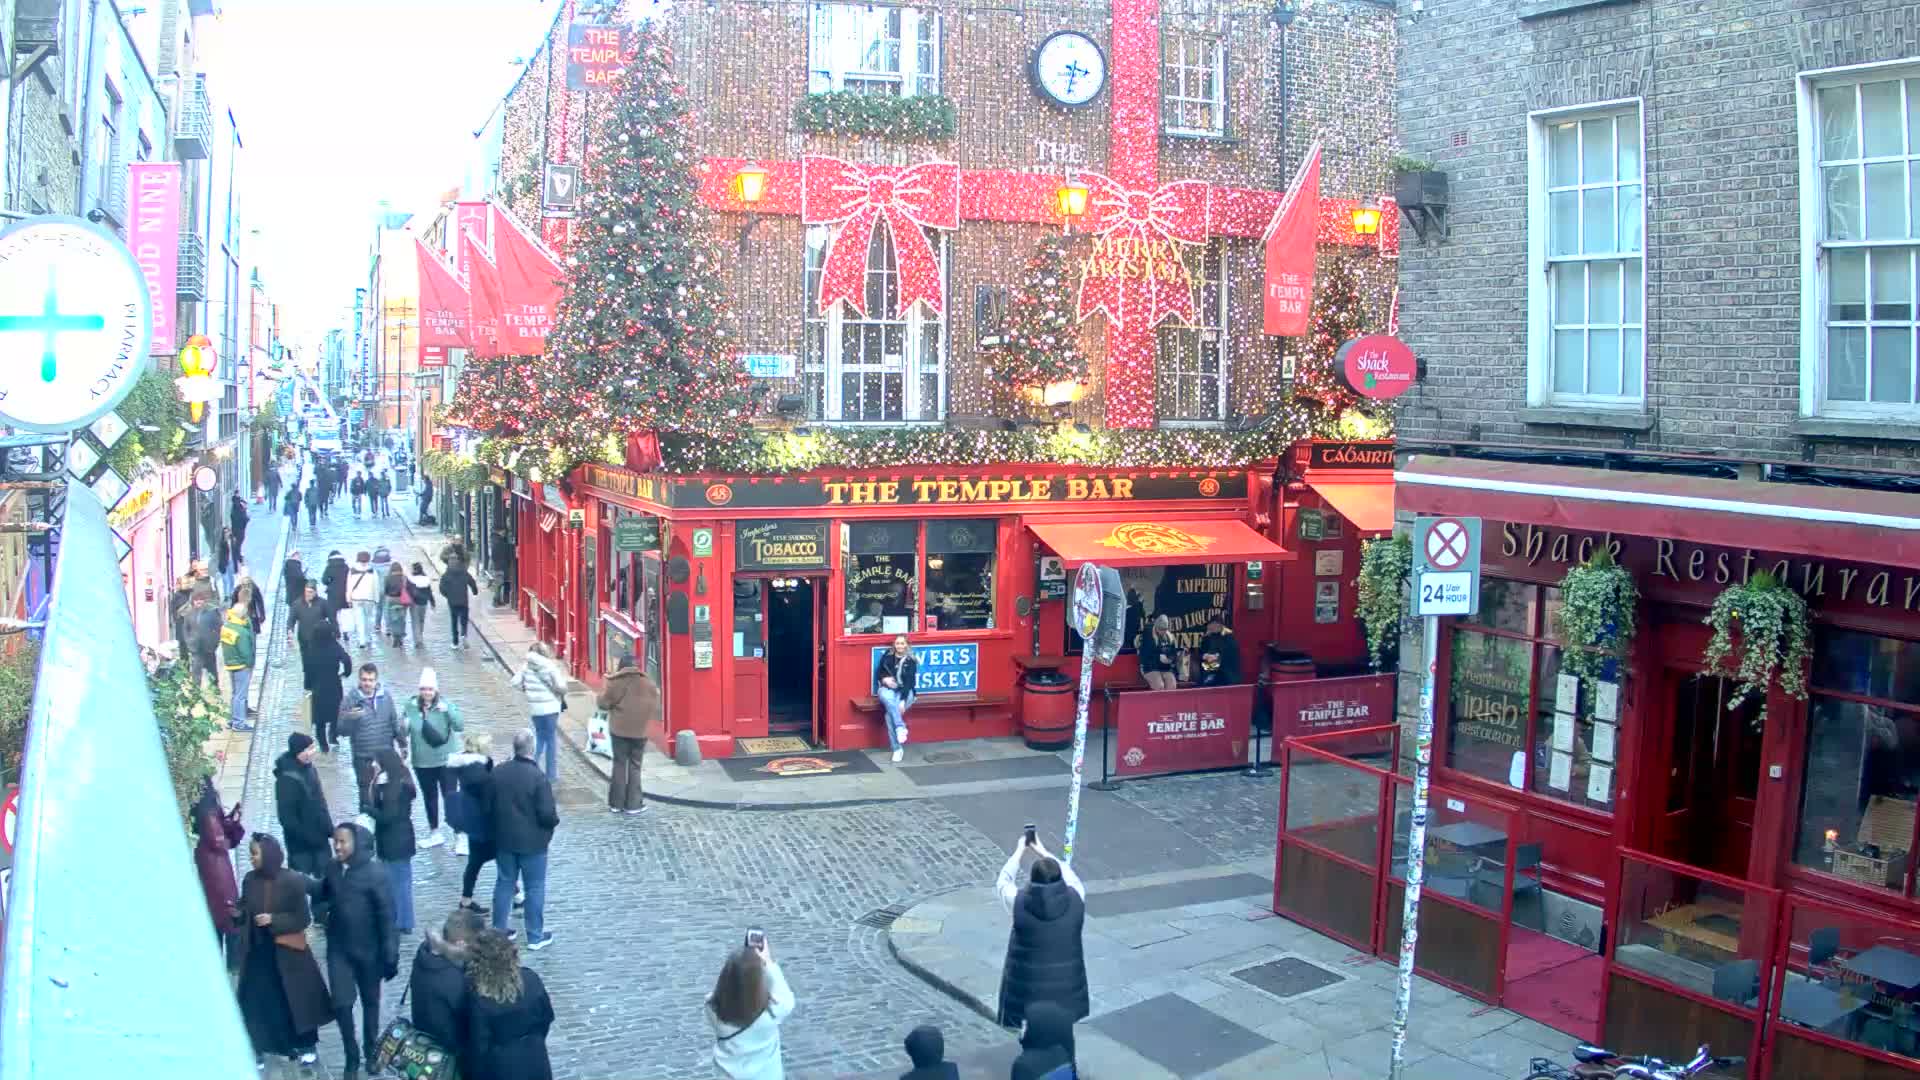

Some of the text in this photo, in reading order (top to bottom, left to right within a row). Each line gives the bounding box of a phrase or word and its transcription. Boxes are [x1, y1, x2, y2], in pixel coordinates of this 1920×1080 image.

[585, 29, 619, 45] THE
[1033, 138, 1084, 163] THE
[138, 170, 172, 233] NINE
[1089, 235, 1180, 262] MERRY
[1281, 273, 1299, 284] THE
[1269, 284, 1306, 300] TEMPL
[522, 304, 546, 314] THE
[1279, 300, 1302, 313] BAR
[504, 313, 554, 326] TEMPL
[518, 327, 550, 338] BAR
[637, 477, 654, 499] BAR
[711, 486, 727, 499] 48
[824, 478, 1134, 504] THE TEMPLE BAR
[1201, 481, 1214, 493] 48
[751, 538, 817, 562] TOBACCO
[1501, 520, 1622, 567] Shack
[874, 555, 890, 563] THE
[849, 565, 893, 589] TEMPLE
[1204, 563, 1228, 578] THE
[1176, 578, 1228, 594] EMPEROR
[1423, 584, 1444, 603] 24
[1212, 592, 1226, 608] OF
[1445, 593, 1468, 603] HOUR
[914, 647, 971, 667] WER'S
[914, 670, 975, 689] ISKEY
[1299, 704, 1369, 721] TEMPLE BAR
[1327, 700, 1345, 709] THE
[1176, 712, 1198, 721] THE
[1147, 718, 1225, 734] TEMPLE BAR
